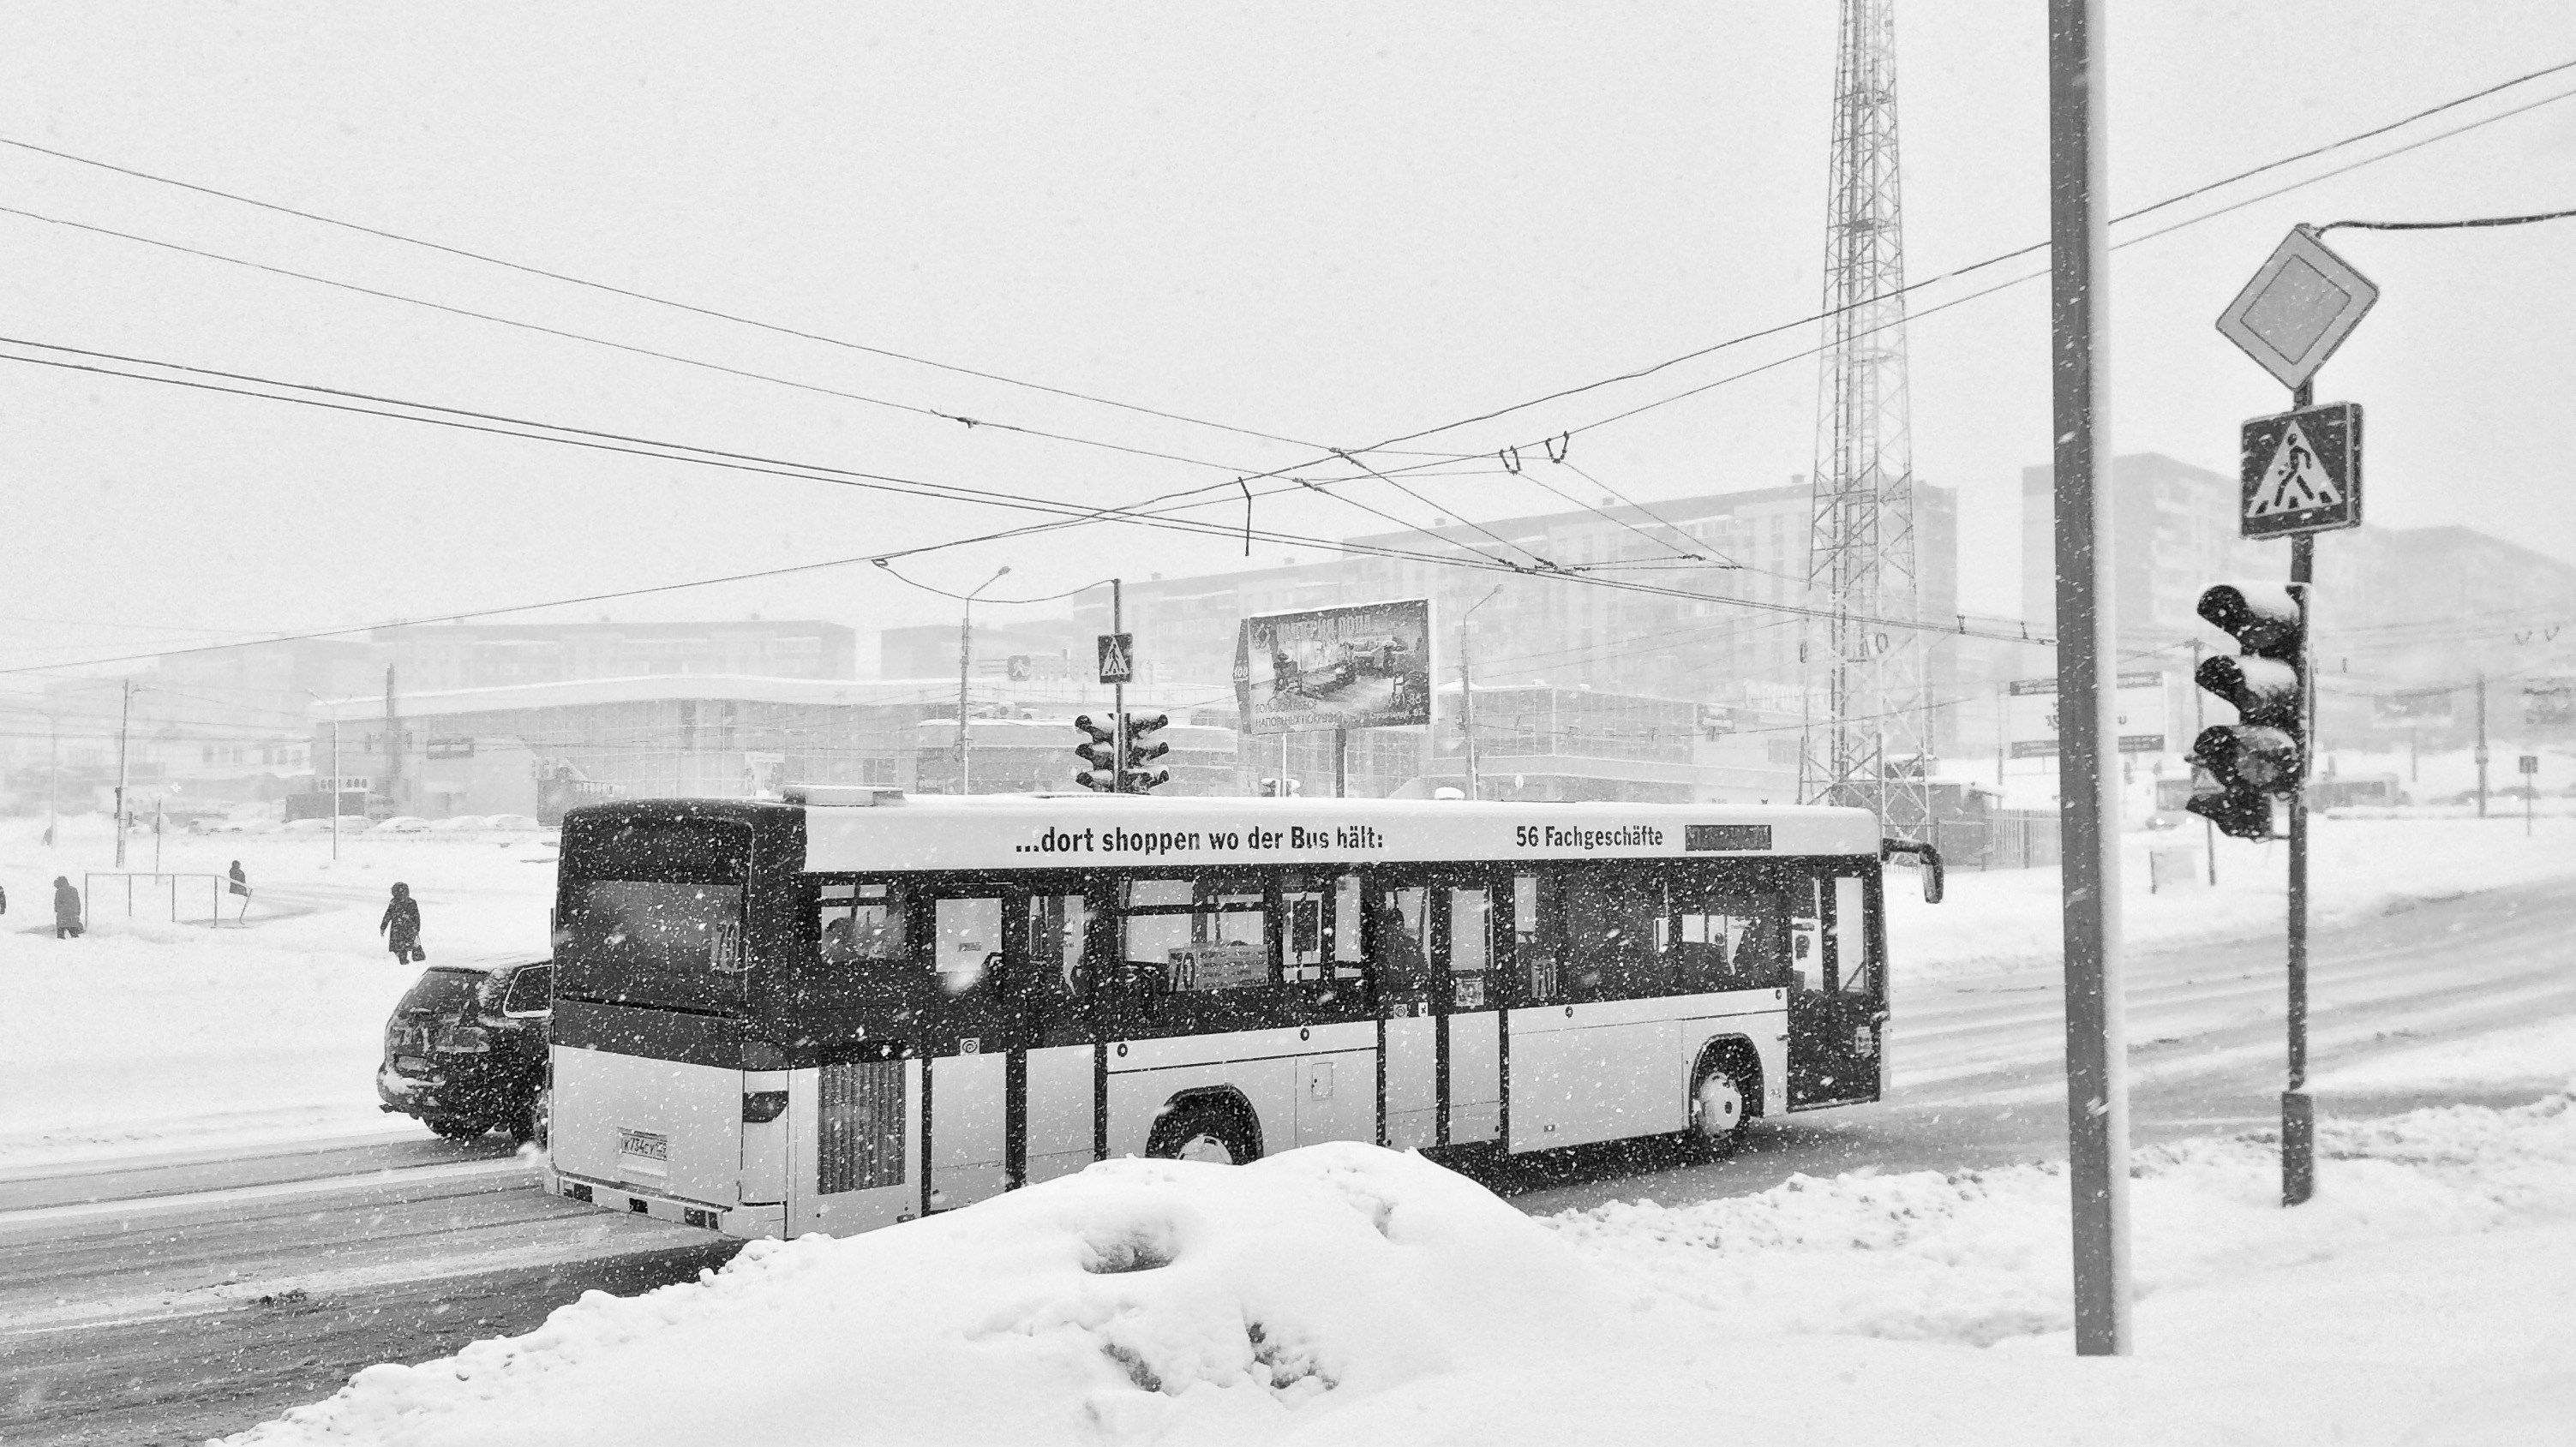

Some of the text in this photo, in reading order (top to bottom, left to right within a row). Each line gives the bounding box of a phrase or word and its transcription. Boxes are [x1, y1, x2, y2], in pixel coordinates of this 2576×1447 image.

[1102, 826, 1201, 856] shoppen
[1208, 832, 1239, 851] wo
[1248, 826, 1284, 850] der
[1291, 825, 1330, 849] Bus
[1337, 824, 1384, 849] hält:
[1516, 823, 1663, 852] 56 Fachgeschäfte
[1169, 952, 1196, 992] 70
